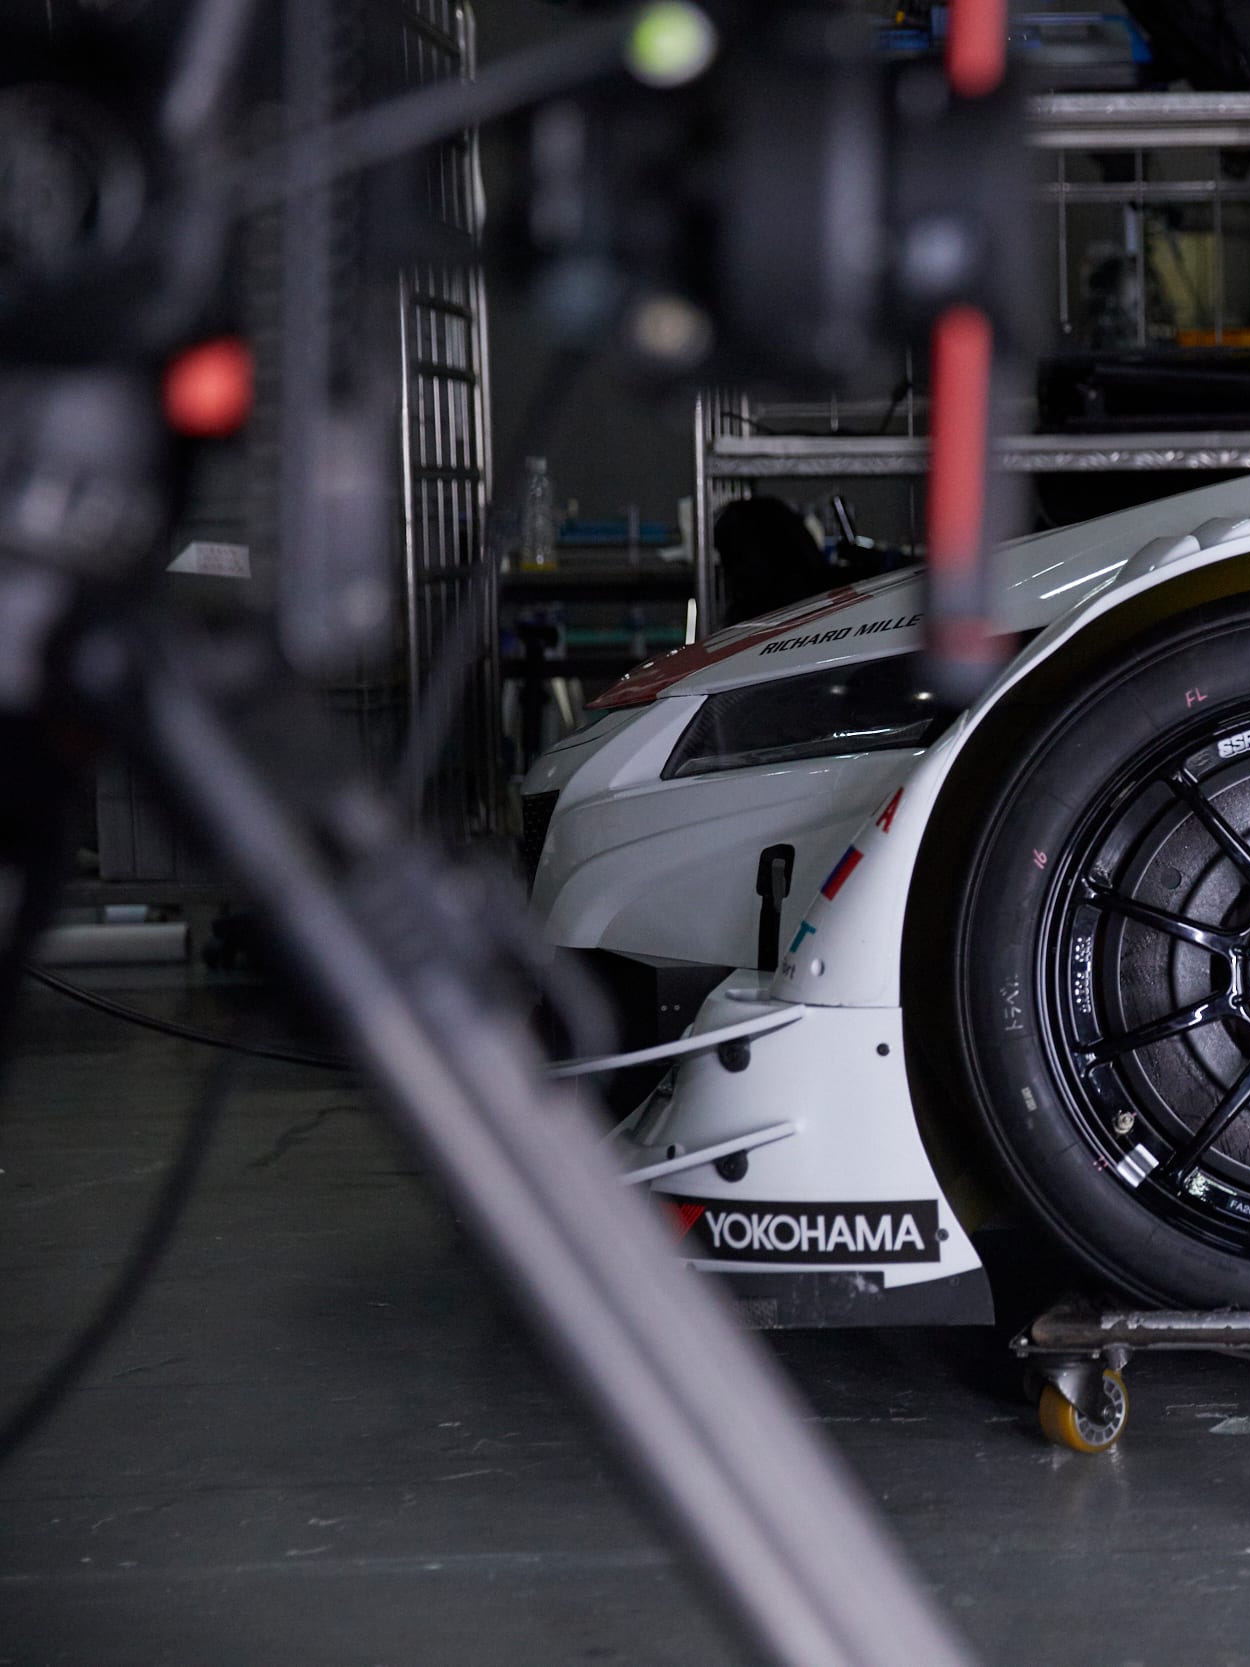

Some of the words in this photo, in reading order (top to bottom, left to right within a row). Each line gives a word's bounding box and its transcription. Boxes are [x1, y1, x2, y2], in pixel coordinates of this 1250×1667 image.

[759, 627, 853, 656] RICHARD
[853, 613, 926, 637] MILLE
[1184, 687, 1208, 709] FL
[1032, 848, 1048, 870] 16
[704, 1211, 926, 1252] YOKOHAMA
